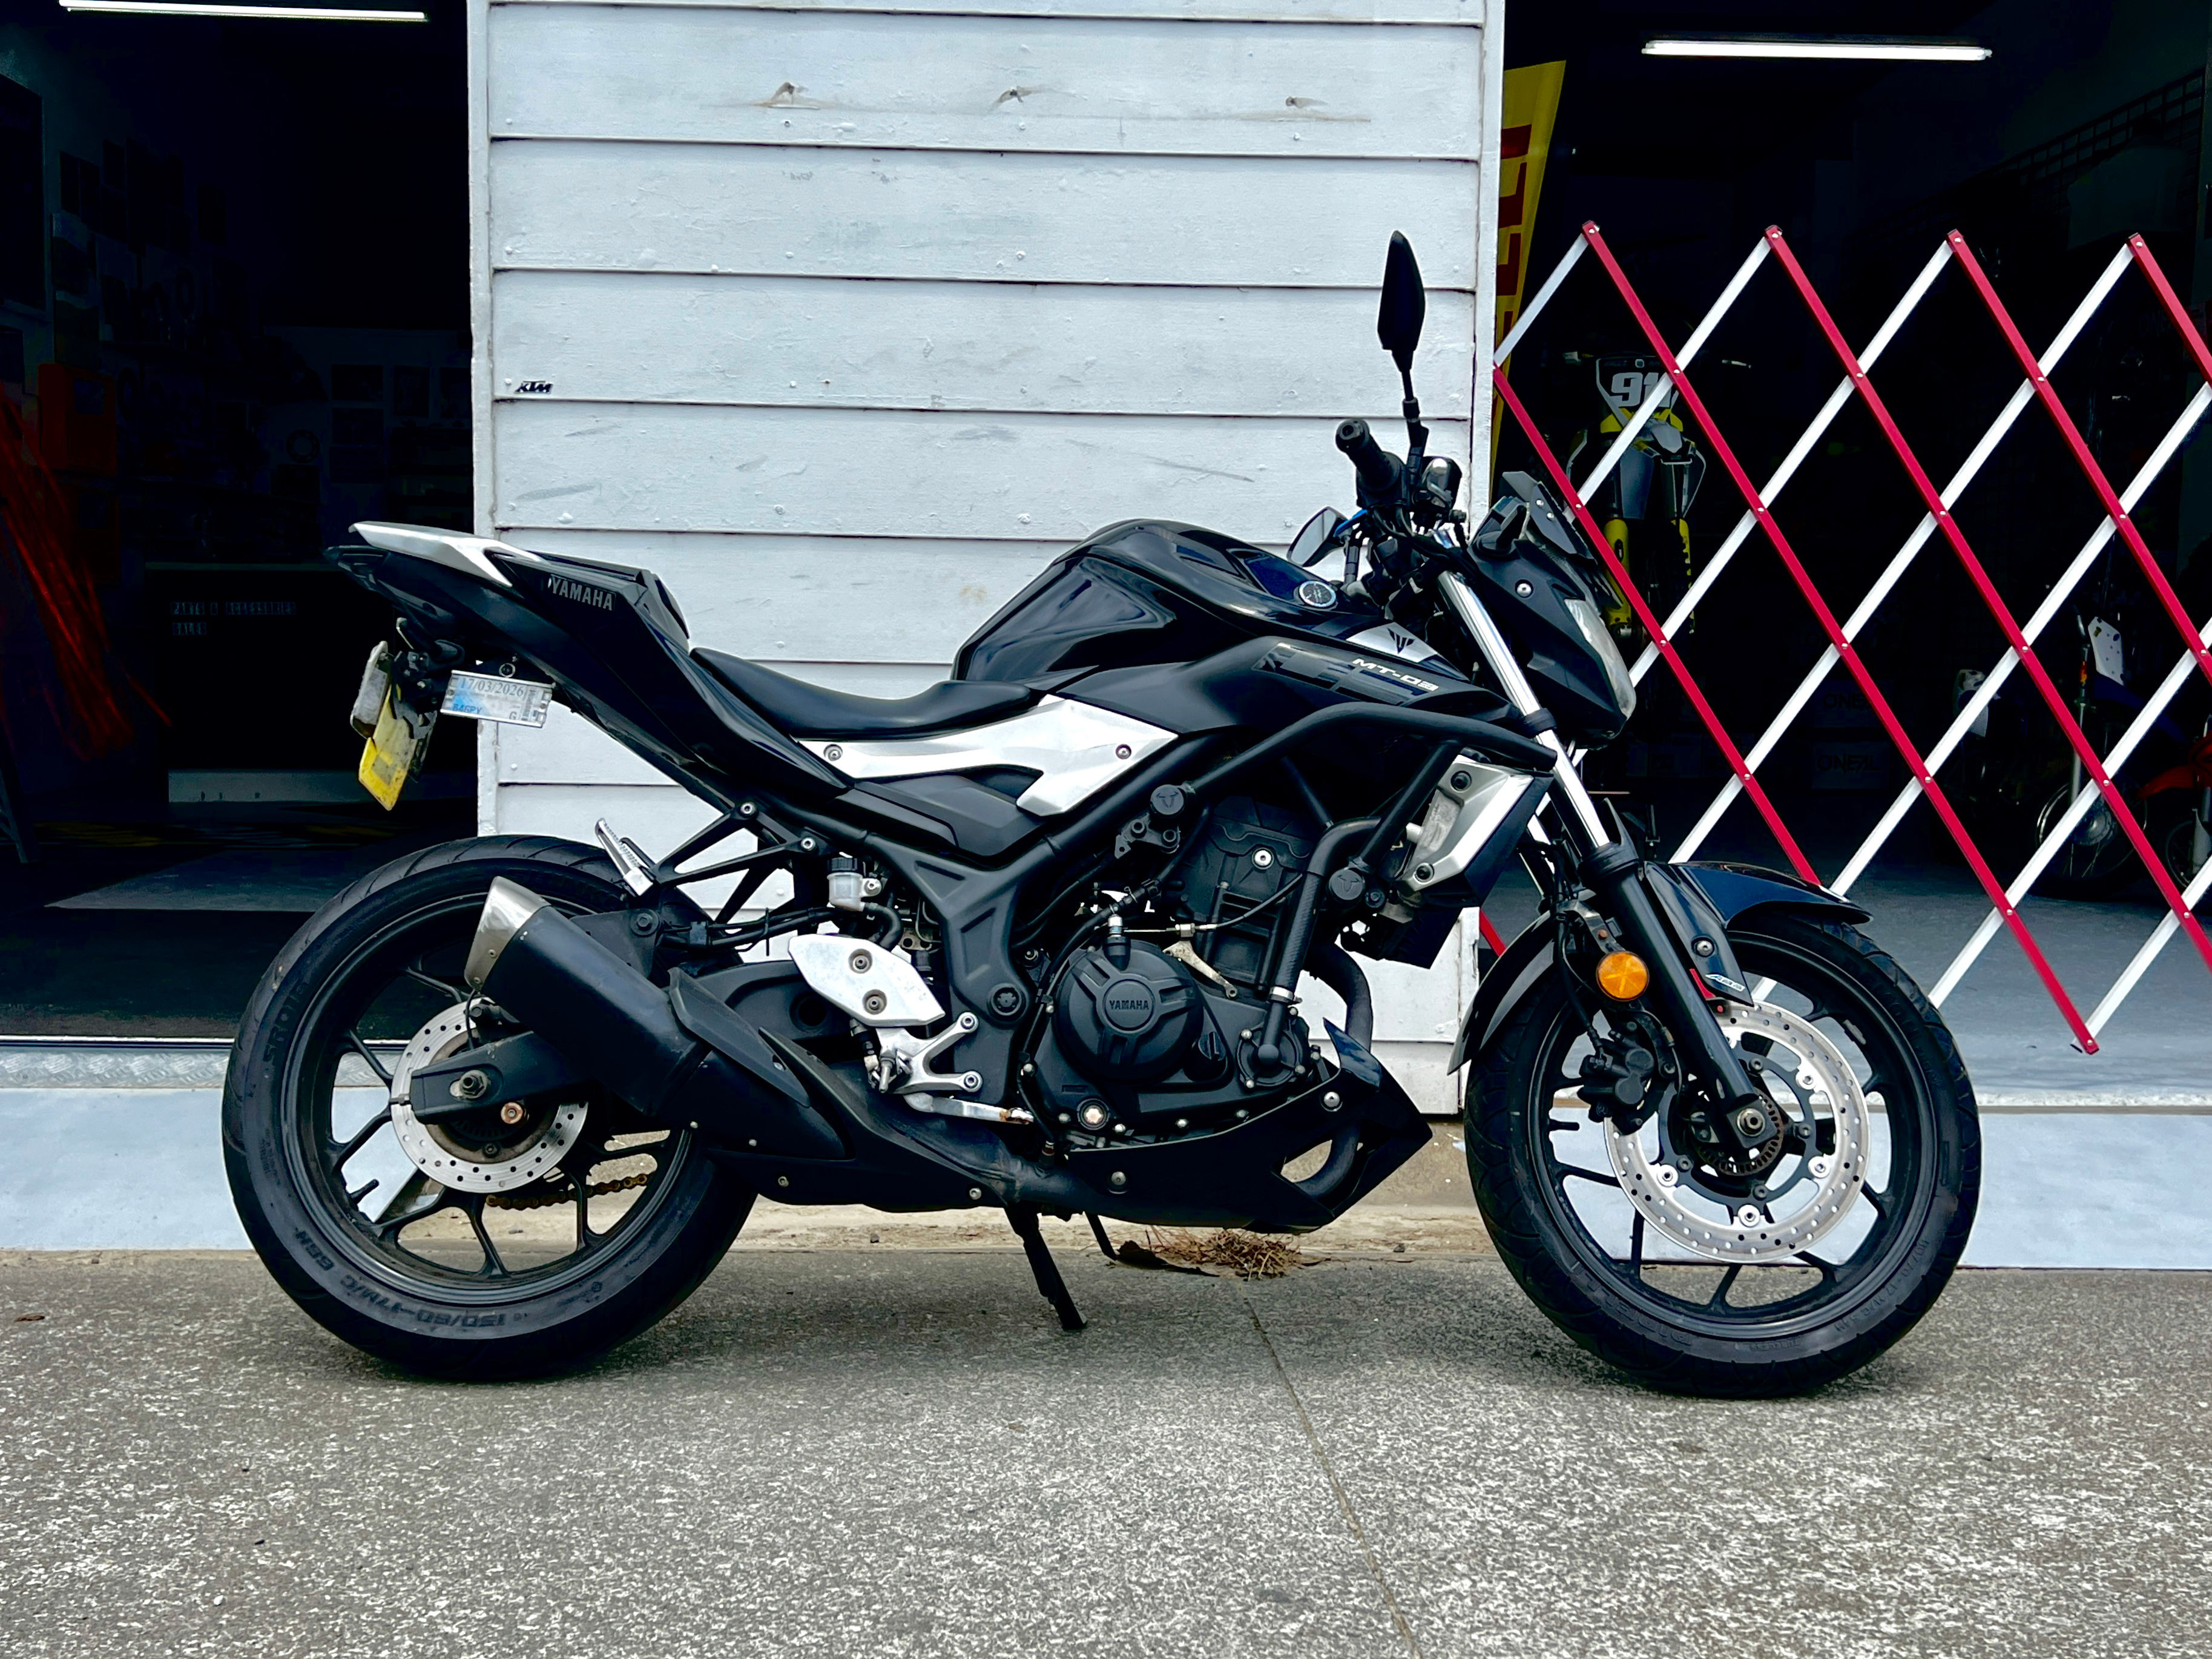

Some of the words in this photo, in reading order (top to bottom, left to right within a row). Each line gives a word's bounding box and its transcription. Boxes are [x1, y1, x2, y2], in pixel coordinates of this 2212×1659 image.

[515, 380, 553, 393] KTM
[551, 576, 613, 611] YAMAHA
[170, 601, 205, 615] PARTS
[225, 601, 296, 615] ACCESSORIES
[172, 621, 208, 636] SALES
[1352, 658, 1439, 691] MT-03
[461, 677, 524, 698] 17/03/2026
[1109, 1000, 1149, 1010] YAMAHA
